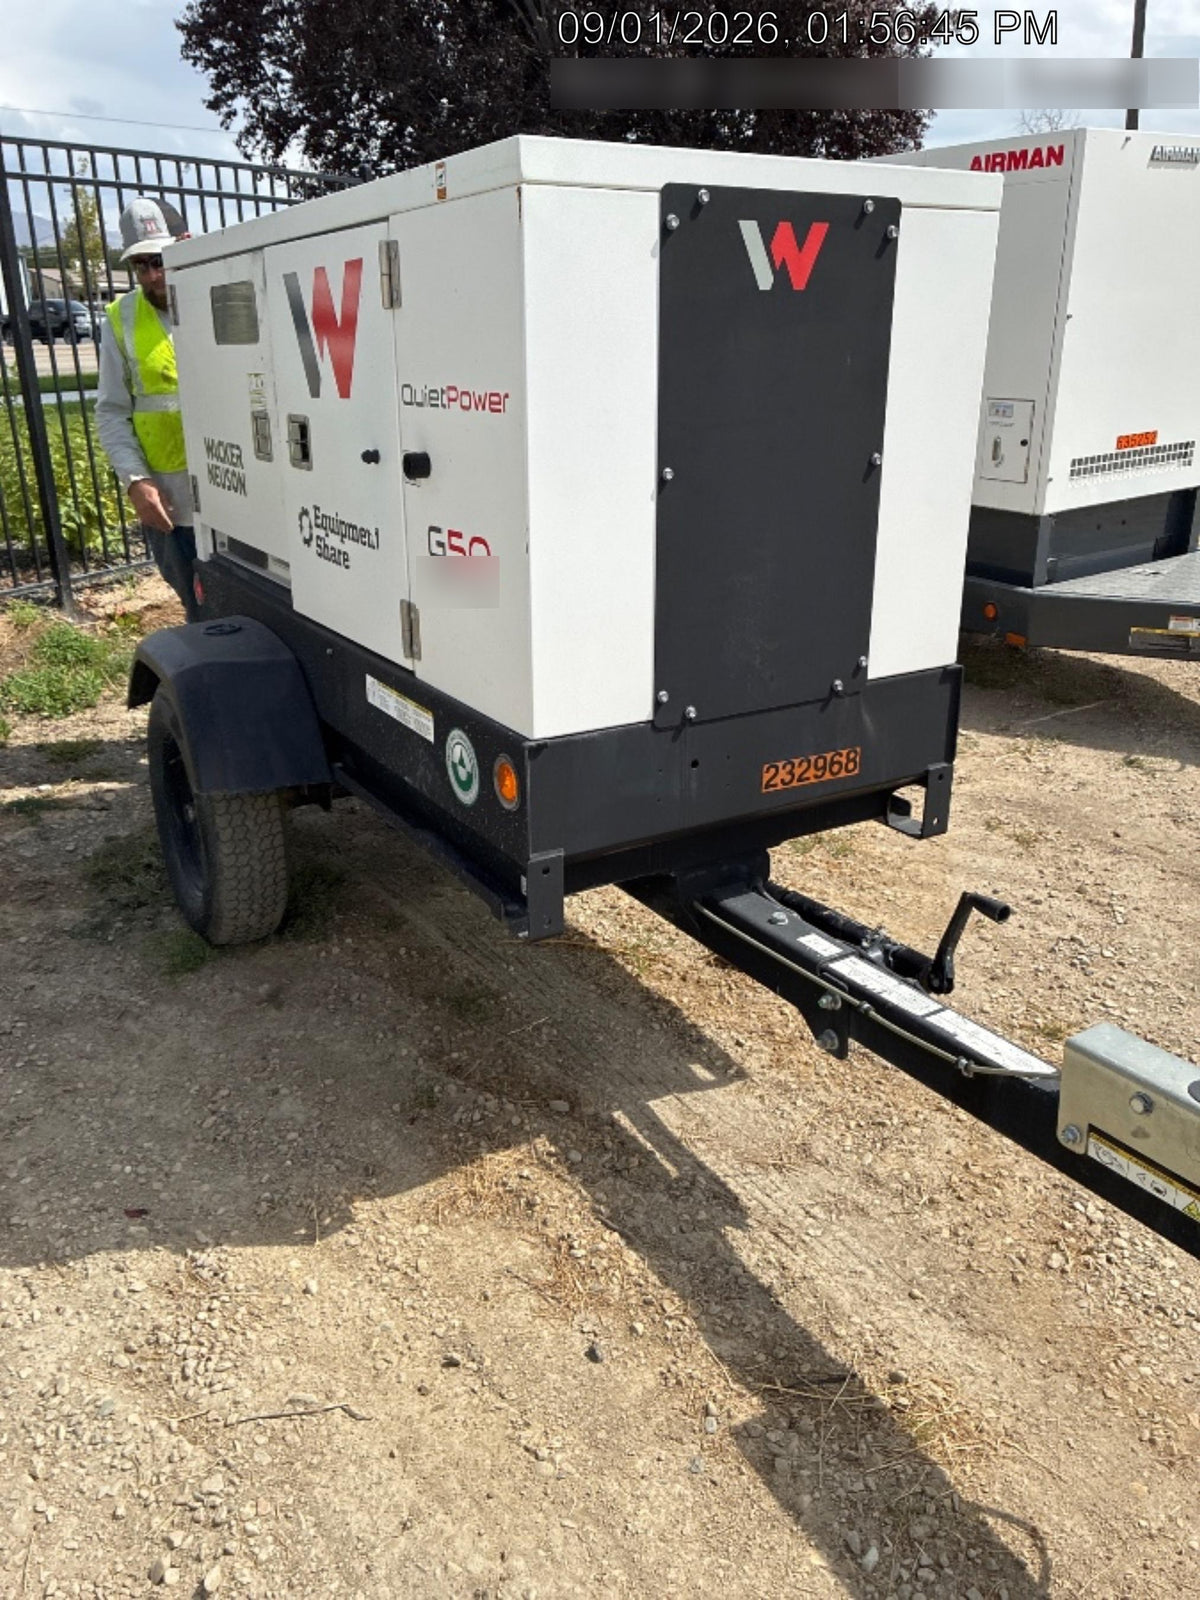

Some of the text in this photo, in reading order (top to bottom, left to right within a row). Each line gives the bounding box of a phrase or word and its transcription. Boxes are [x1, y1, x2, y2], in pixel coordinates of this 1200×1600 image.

[970, 144, 1065, 173] AIRMAN
[203, 436, 244, 470] WACKER
[206, 462, 247, 498] NEUSON
[316, 534, 350, 570] Share
[427, 525, 491, 556] G50
[763, 749, 859, 790] 232968
